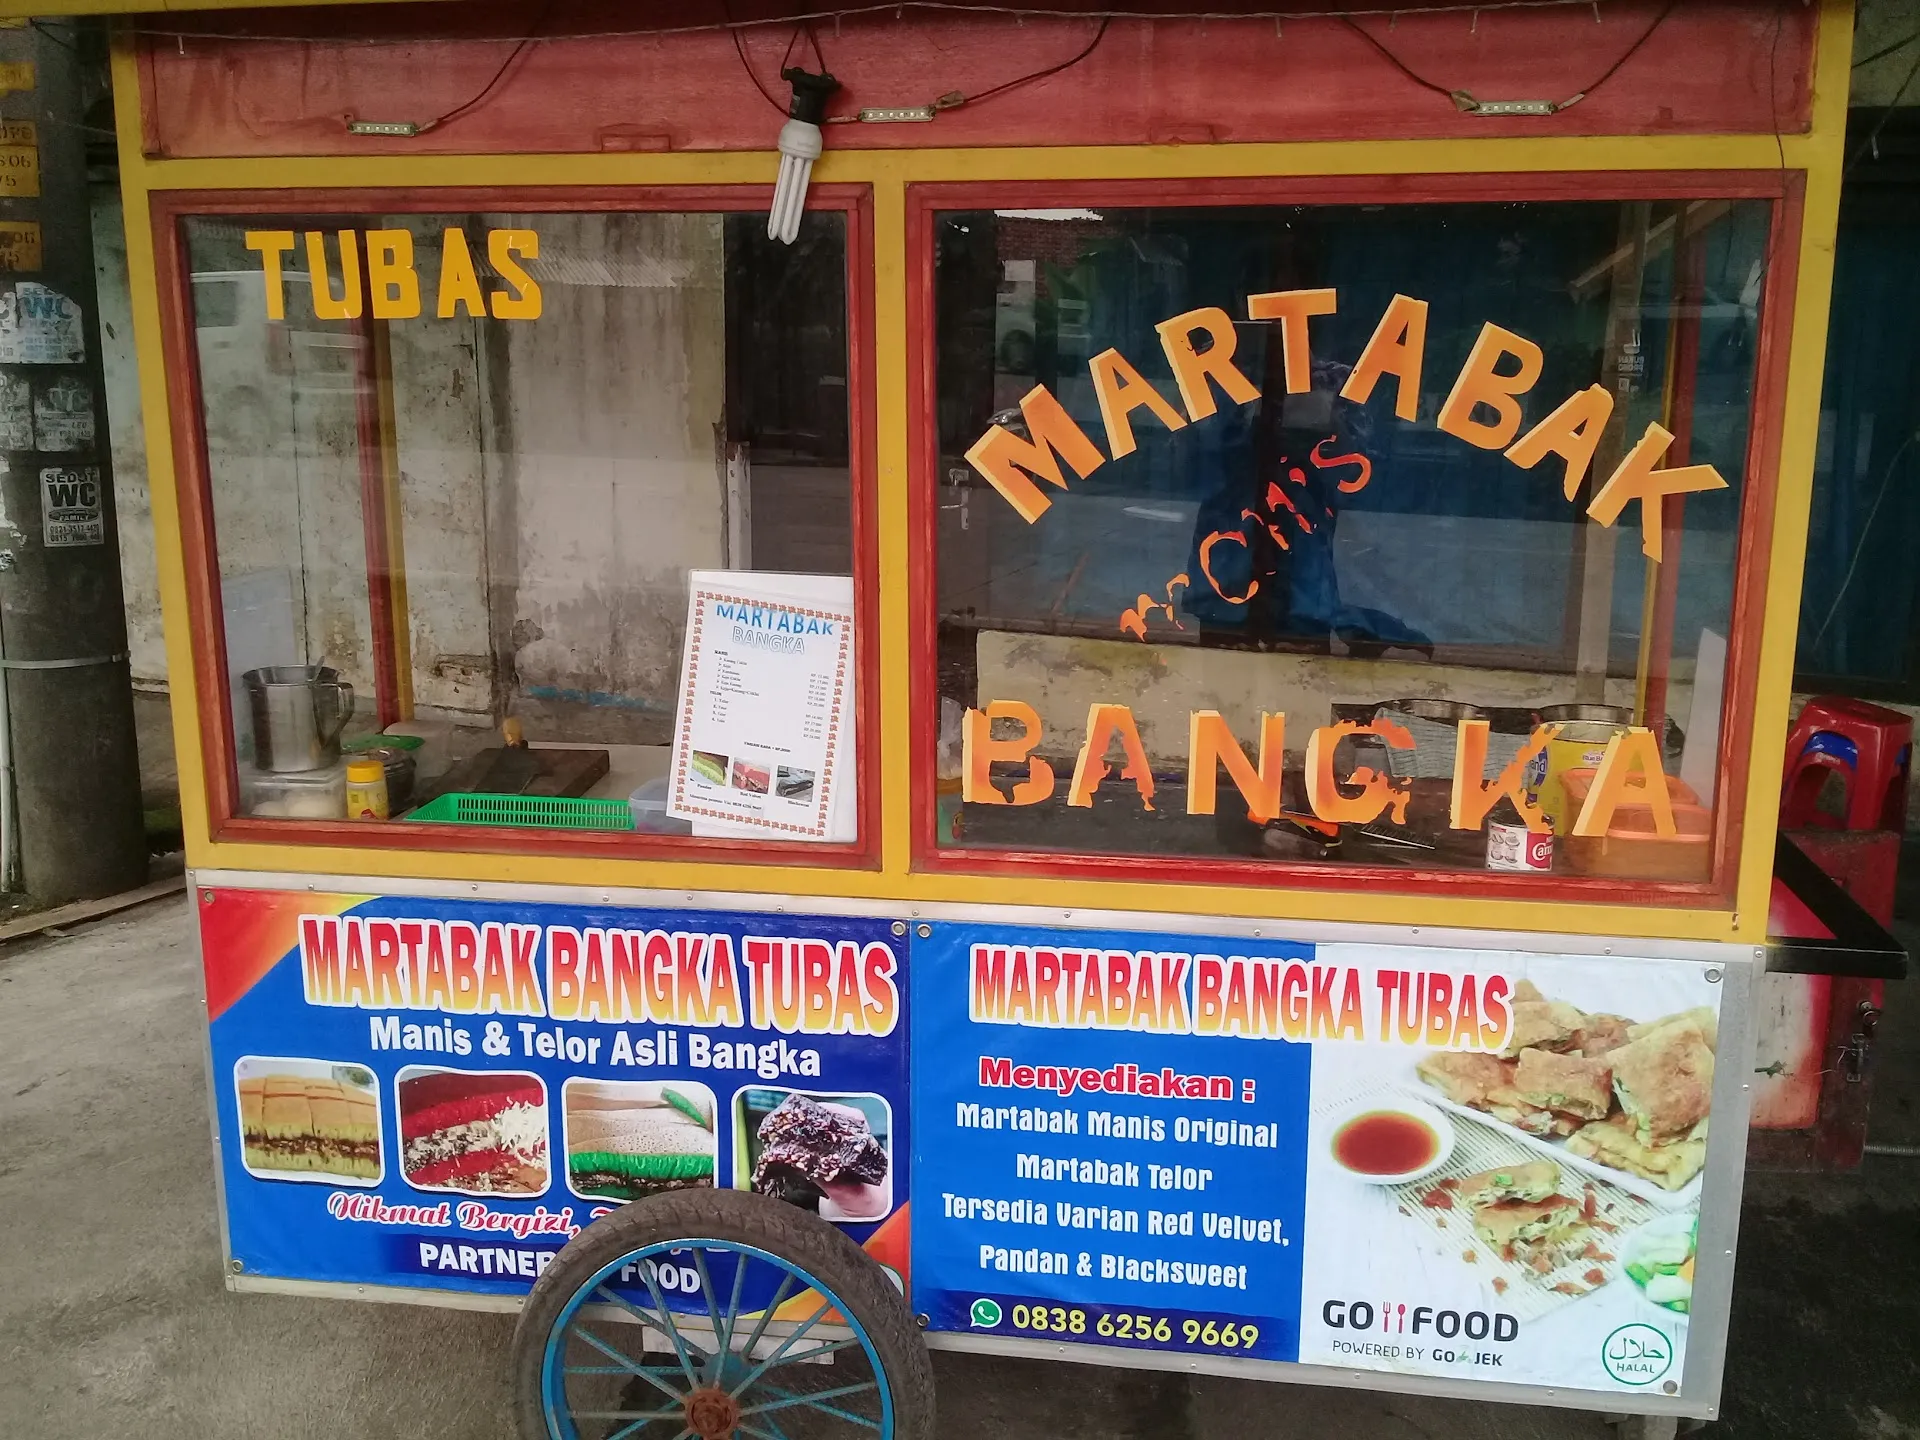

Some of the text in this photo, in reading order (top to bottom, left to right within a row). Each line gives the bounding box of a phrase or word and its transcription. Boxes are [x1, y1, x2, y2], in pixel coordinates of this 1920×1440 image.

[244, 227, 542, 320] TUBAS
[963, 287, 1730, 563] MARTABAK
[48, 482, 96, 507] WC
[716, 604, 834, 636] MARTABAK
[732, 625, 805, 655] BANGKA
[961, 699, 1678, 837] BANGKA
[298, 914, 902, 1037] MARTABAK BANGKA TUBAS
[970, 943, 1516, 1054] MARTABAK BANGKA TUBAS
[370, 1017, 822, 1080] Manis & Telor Asli Bangka
[978, 1057, 1235, 1102] Menyediakan
[956, 1102, 1278, 1149] Martabak Manis Original
[1016, 1153, 1213, 1191] Martabak Telor
[456, 1204, 582, 1239] Bergizi,
[942, 1192, 1290, 1248] Tersedia Varian Red Velvet,
[620, 1259, 701, 1294] FOOD
[979, 1244, 1248, 1291] Pandan & Blacksweet
[1011, 1304, 1260, 1349] 0838 6256 9669
[1322, 1299, 1519, 1343] GO FOOD
[1331, 1339, 1504, 1367] POWERED BY GO JEK
[1608, 1336, 1666, 1361] حلال
[1616, 1362, 1655, 1374] HALAL
